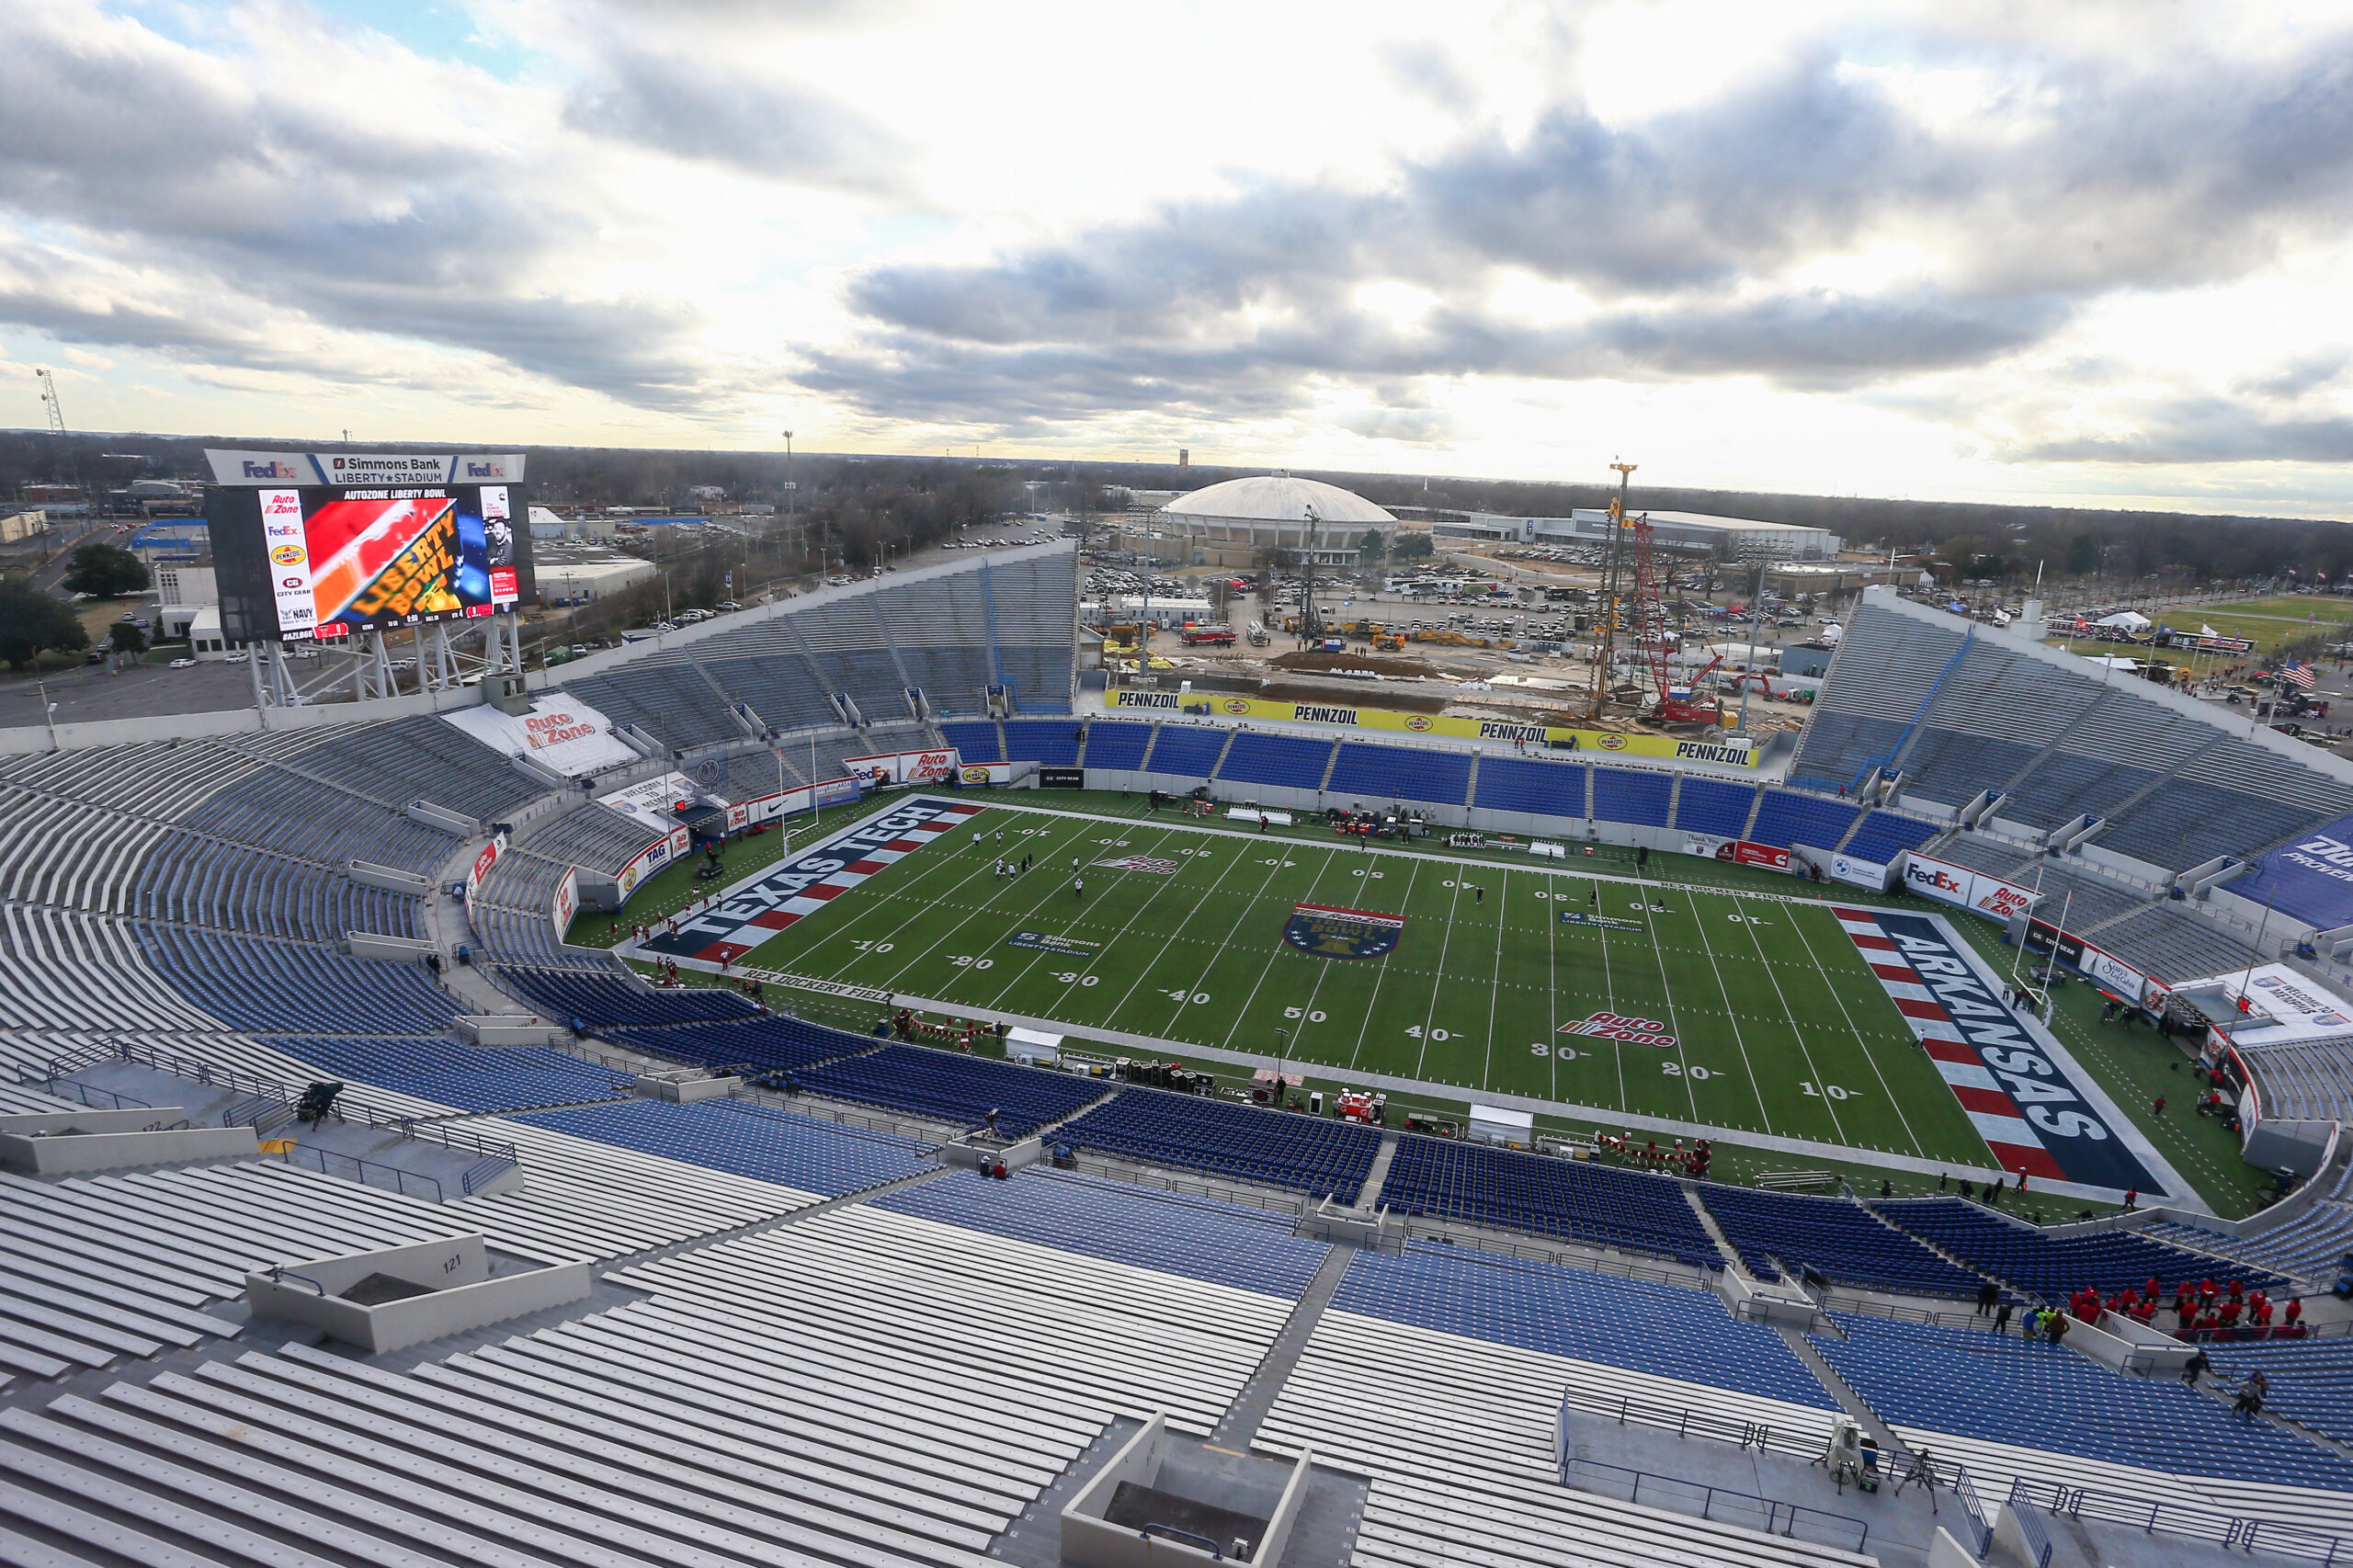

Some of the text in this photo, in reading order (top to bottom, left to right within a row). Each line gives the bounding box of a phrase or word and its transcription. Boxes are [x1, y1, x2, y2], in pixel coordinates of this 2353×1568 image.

[243, 461, 297, 478] FedEx
[349, 459, 439, 471] Simmons Bank
[468, 463, 505, 477] FedEx
[335, 473, 442, 483] LIBERTY STADIUM
[272, 494, 295, 504] Auto
[344, 489, 447, 500] AUTOZONE LIBERTY BOWL
[274, 505, 299, 514] Zone
[268, 526, 298, 536] FedEx
[276, 550, 301, 561] PENNZOIL
[387, 546, 454, 616] BOWL
[292, 608, 313, 619] NAVY
[1118, 691, 1180, 710] PENNZOIL
[525, 713, 574, 733] Auto
[1294, 706, 1358, 725] PENNZOIL
[543, 722, 596, 744] Zone
[1480, 722, 1548, 744] PENNZOIL
[919, 754, 947, 767] Auto
[1676, 742, 1750, 766] PENNZOIL
[919, 767, 949, 778] Zone
[966, 770, 987, 779] PENNZOIL
[621, 780, 665, 799] WELCOME
[642, 790, 682, 809] MEMPHIS
[1688, 835, 1706, 843] Thank
[647, 845, 665, 864] TAG
[676, 806, 944, 935] TEXAS TECH
[1906, 862, 1960, 893] FedEx
[1691, 885, 1750, 896] DOCKERY
[1755, 893, 1792, 902] FIELD
[1994, 887, 2029, 907] Auto
[1588, 914, 1643, 925] Simmons
[1309, 924, 1375, 940] BOWL
[856, 940, 895, 954] 10
[1040, 939, 1072, 948] Bank
[1044, 935, 1101, 947] Simmons
[2046, 937, 2059, 947] CITY
[2059, 945, 2075, 956] GEAR
[1050, 947, 1090, 957] STADIUM
[952, 955, 994, 971] 20
[743, 971, 894, 1003] REX DOCKERY FIELD
[1058, 971, 1099, 987] 30
[1167, 989, 1211, 1006] 40
[2268, 988, 2316, 1015] MEMPHIS
[2282, 984, 2335, 1015] WELCOME TO
[1284, 1006, 1327, 1024] 50
[1586, 1012, 1665, 1031] Auto
[1404, 1025, 1450, 1042] 40
[1588, 1026, 1676, 1046] Zone
[1890, 932, 2108, 1140] ARKANSAS
[1530, 1042, 1577, 1061] 30
[1661, 1062, 1710, 1081] 20
[1799, 1082, 1848, 1101] 10
[443, 1254, 461, 1274] 121
